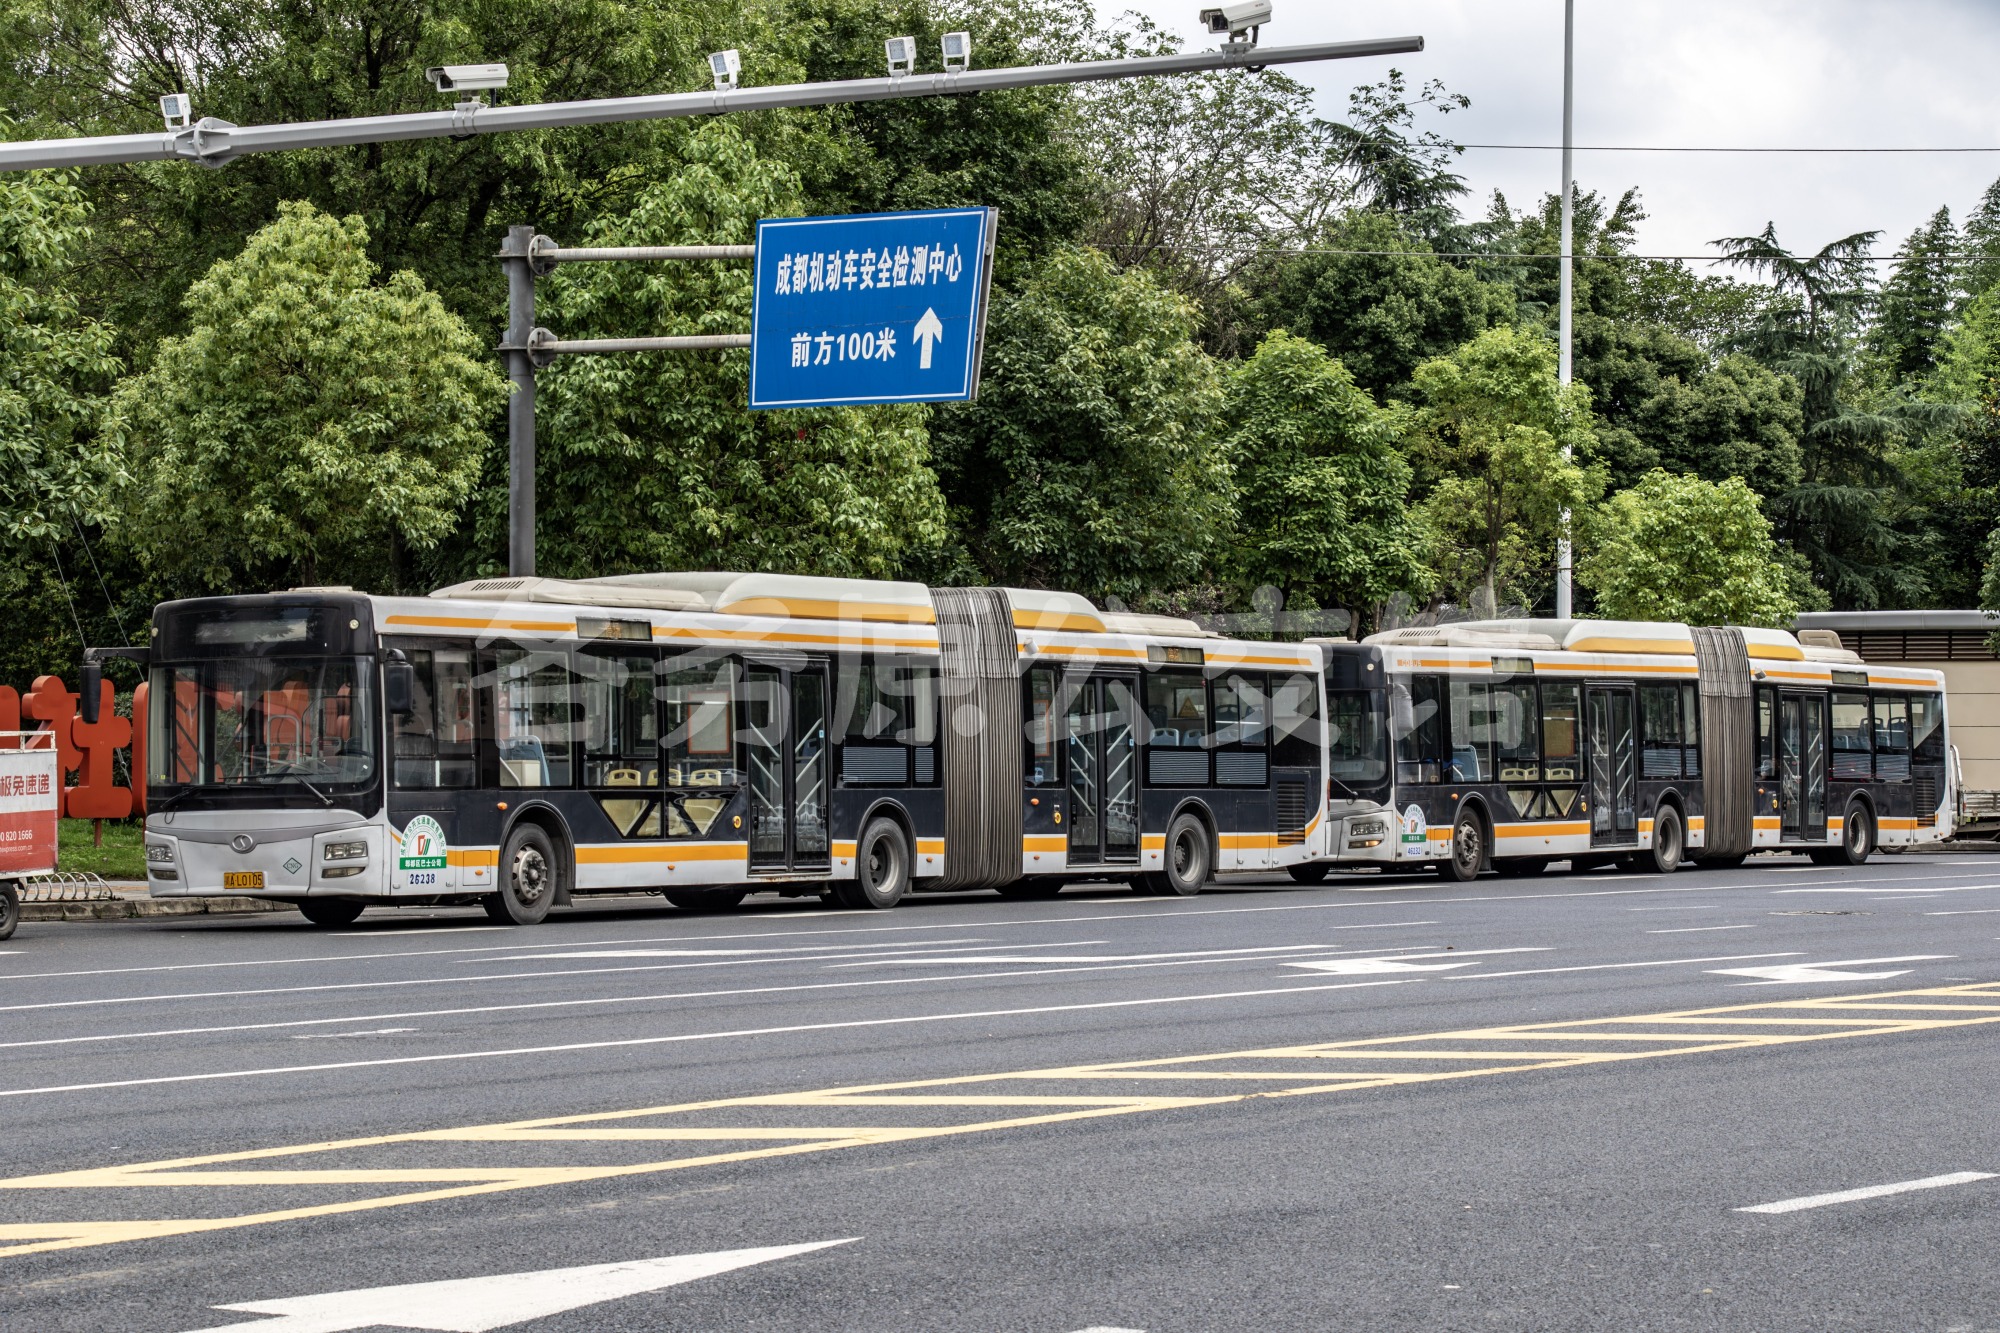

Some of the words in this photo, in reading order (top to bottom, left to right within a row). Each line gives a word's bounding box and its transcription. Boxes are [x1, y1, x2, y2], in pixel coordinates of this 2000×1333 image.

[775, 242, 962, 296] 成都机动车安全检测中心
[791, 327, 897, 368] 前方100米
[0, 774, 50, 797] 极兔速递
[6, 831, 17, 841] 820
[18, 830, 33, 840] 1666
[410, 873, 435, 884] 26238
